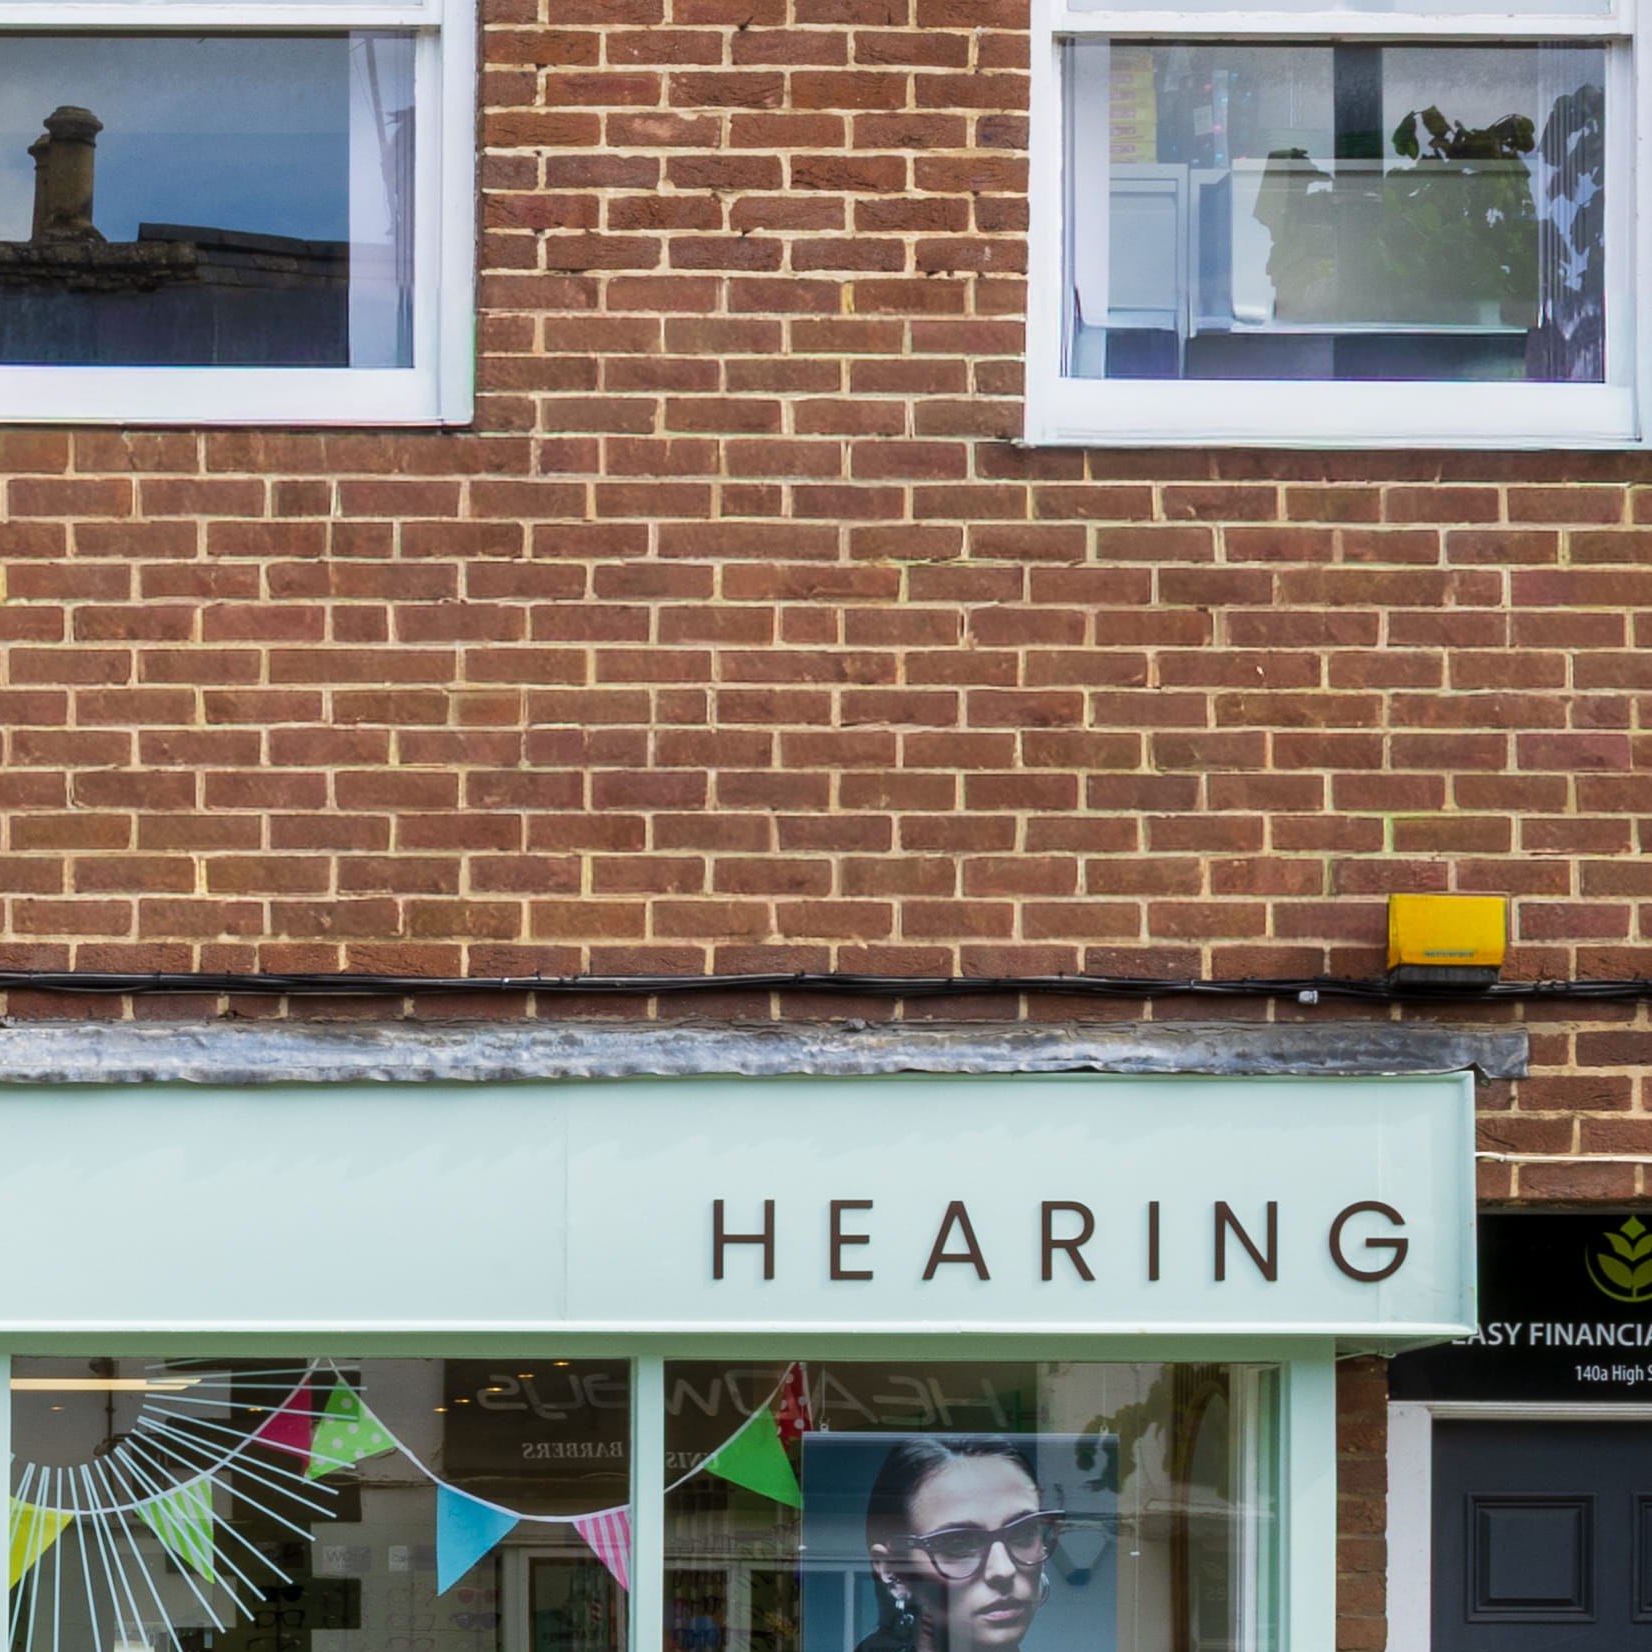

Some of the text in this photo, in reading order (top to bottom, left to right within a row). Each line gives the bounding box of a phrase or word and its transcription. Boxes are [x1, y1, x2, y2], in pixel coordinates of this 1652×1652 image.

[712, 1199, 1409, 1285] HEARING
[1574, 1365, 1608, 1381] 140a
[1612, 1365, 1644, 1386] High
